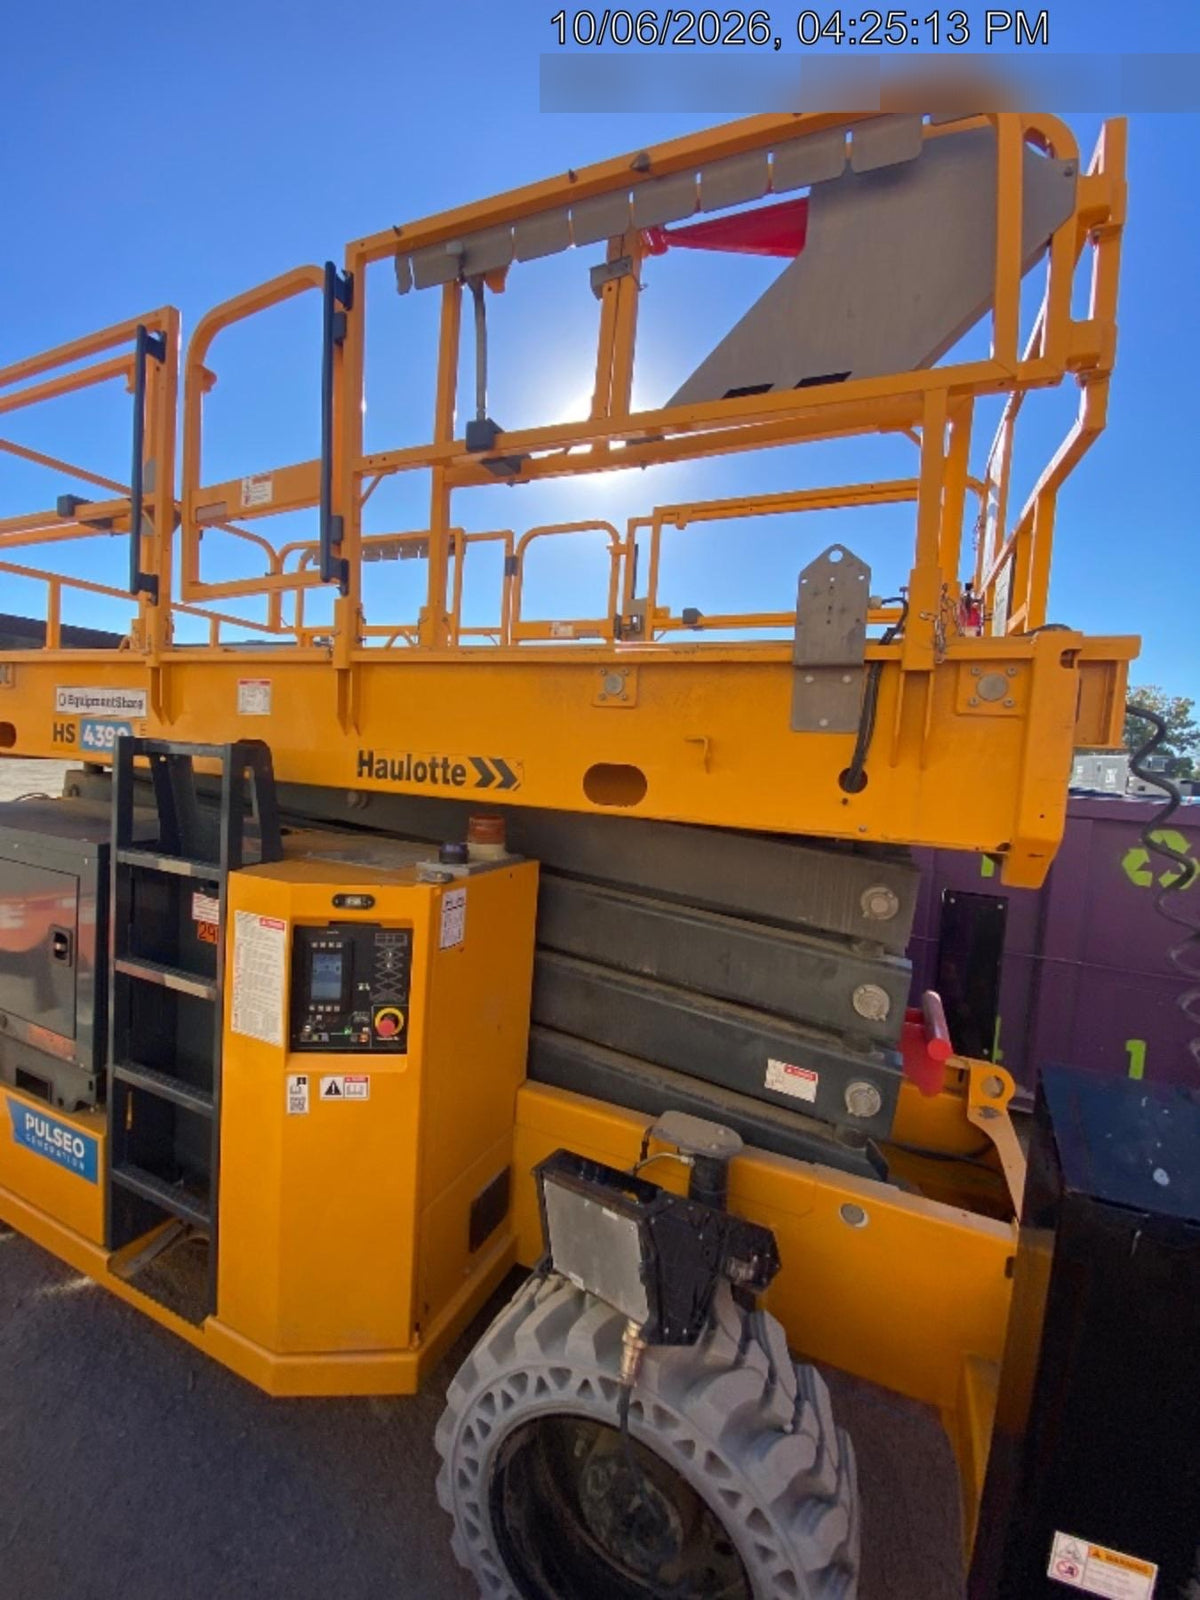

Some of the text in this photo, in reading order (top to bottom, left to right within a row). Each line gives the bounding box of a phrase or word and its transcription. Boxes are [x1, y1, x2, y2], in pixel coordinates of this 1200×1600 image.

[53, 722, 76, 744] HS
[357, 749, 467, 787] Haulotte
[1126, 1039, 1146, 1080] 1
[24, 1112, 85, 1159] PULSEO
